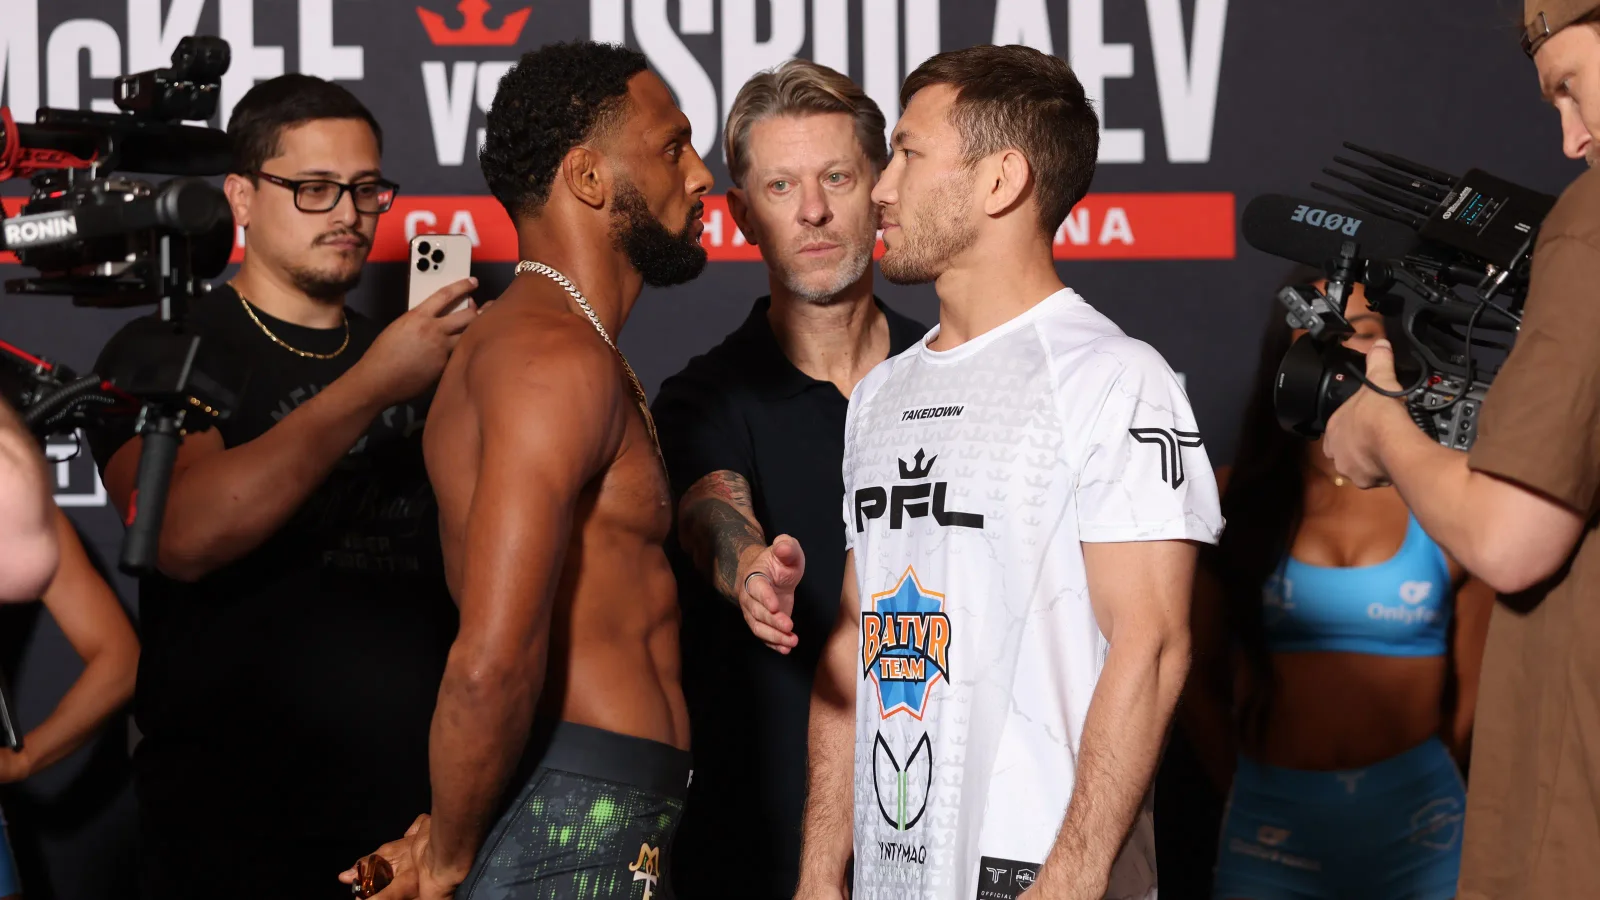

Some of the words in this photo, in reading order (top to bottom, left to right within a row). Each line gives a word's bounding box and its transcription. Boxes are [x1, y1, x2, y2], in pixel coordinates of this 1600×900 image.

[5, 215, 77, 244] RONIN
[1290, 204, 1362, 236] RØDE
[901, 405, 965, 422] TAKEDOWN
[854, 481, 985, 533] PFL
[862, 612, 951, 682] BATYR
[879, 656, 926, 682] TEAM
[878, 841, 927, 865] YNTYMAQ
[980, 890, 1012, 900] OFFICIAL
